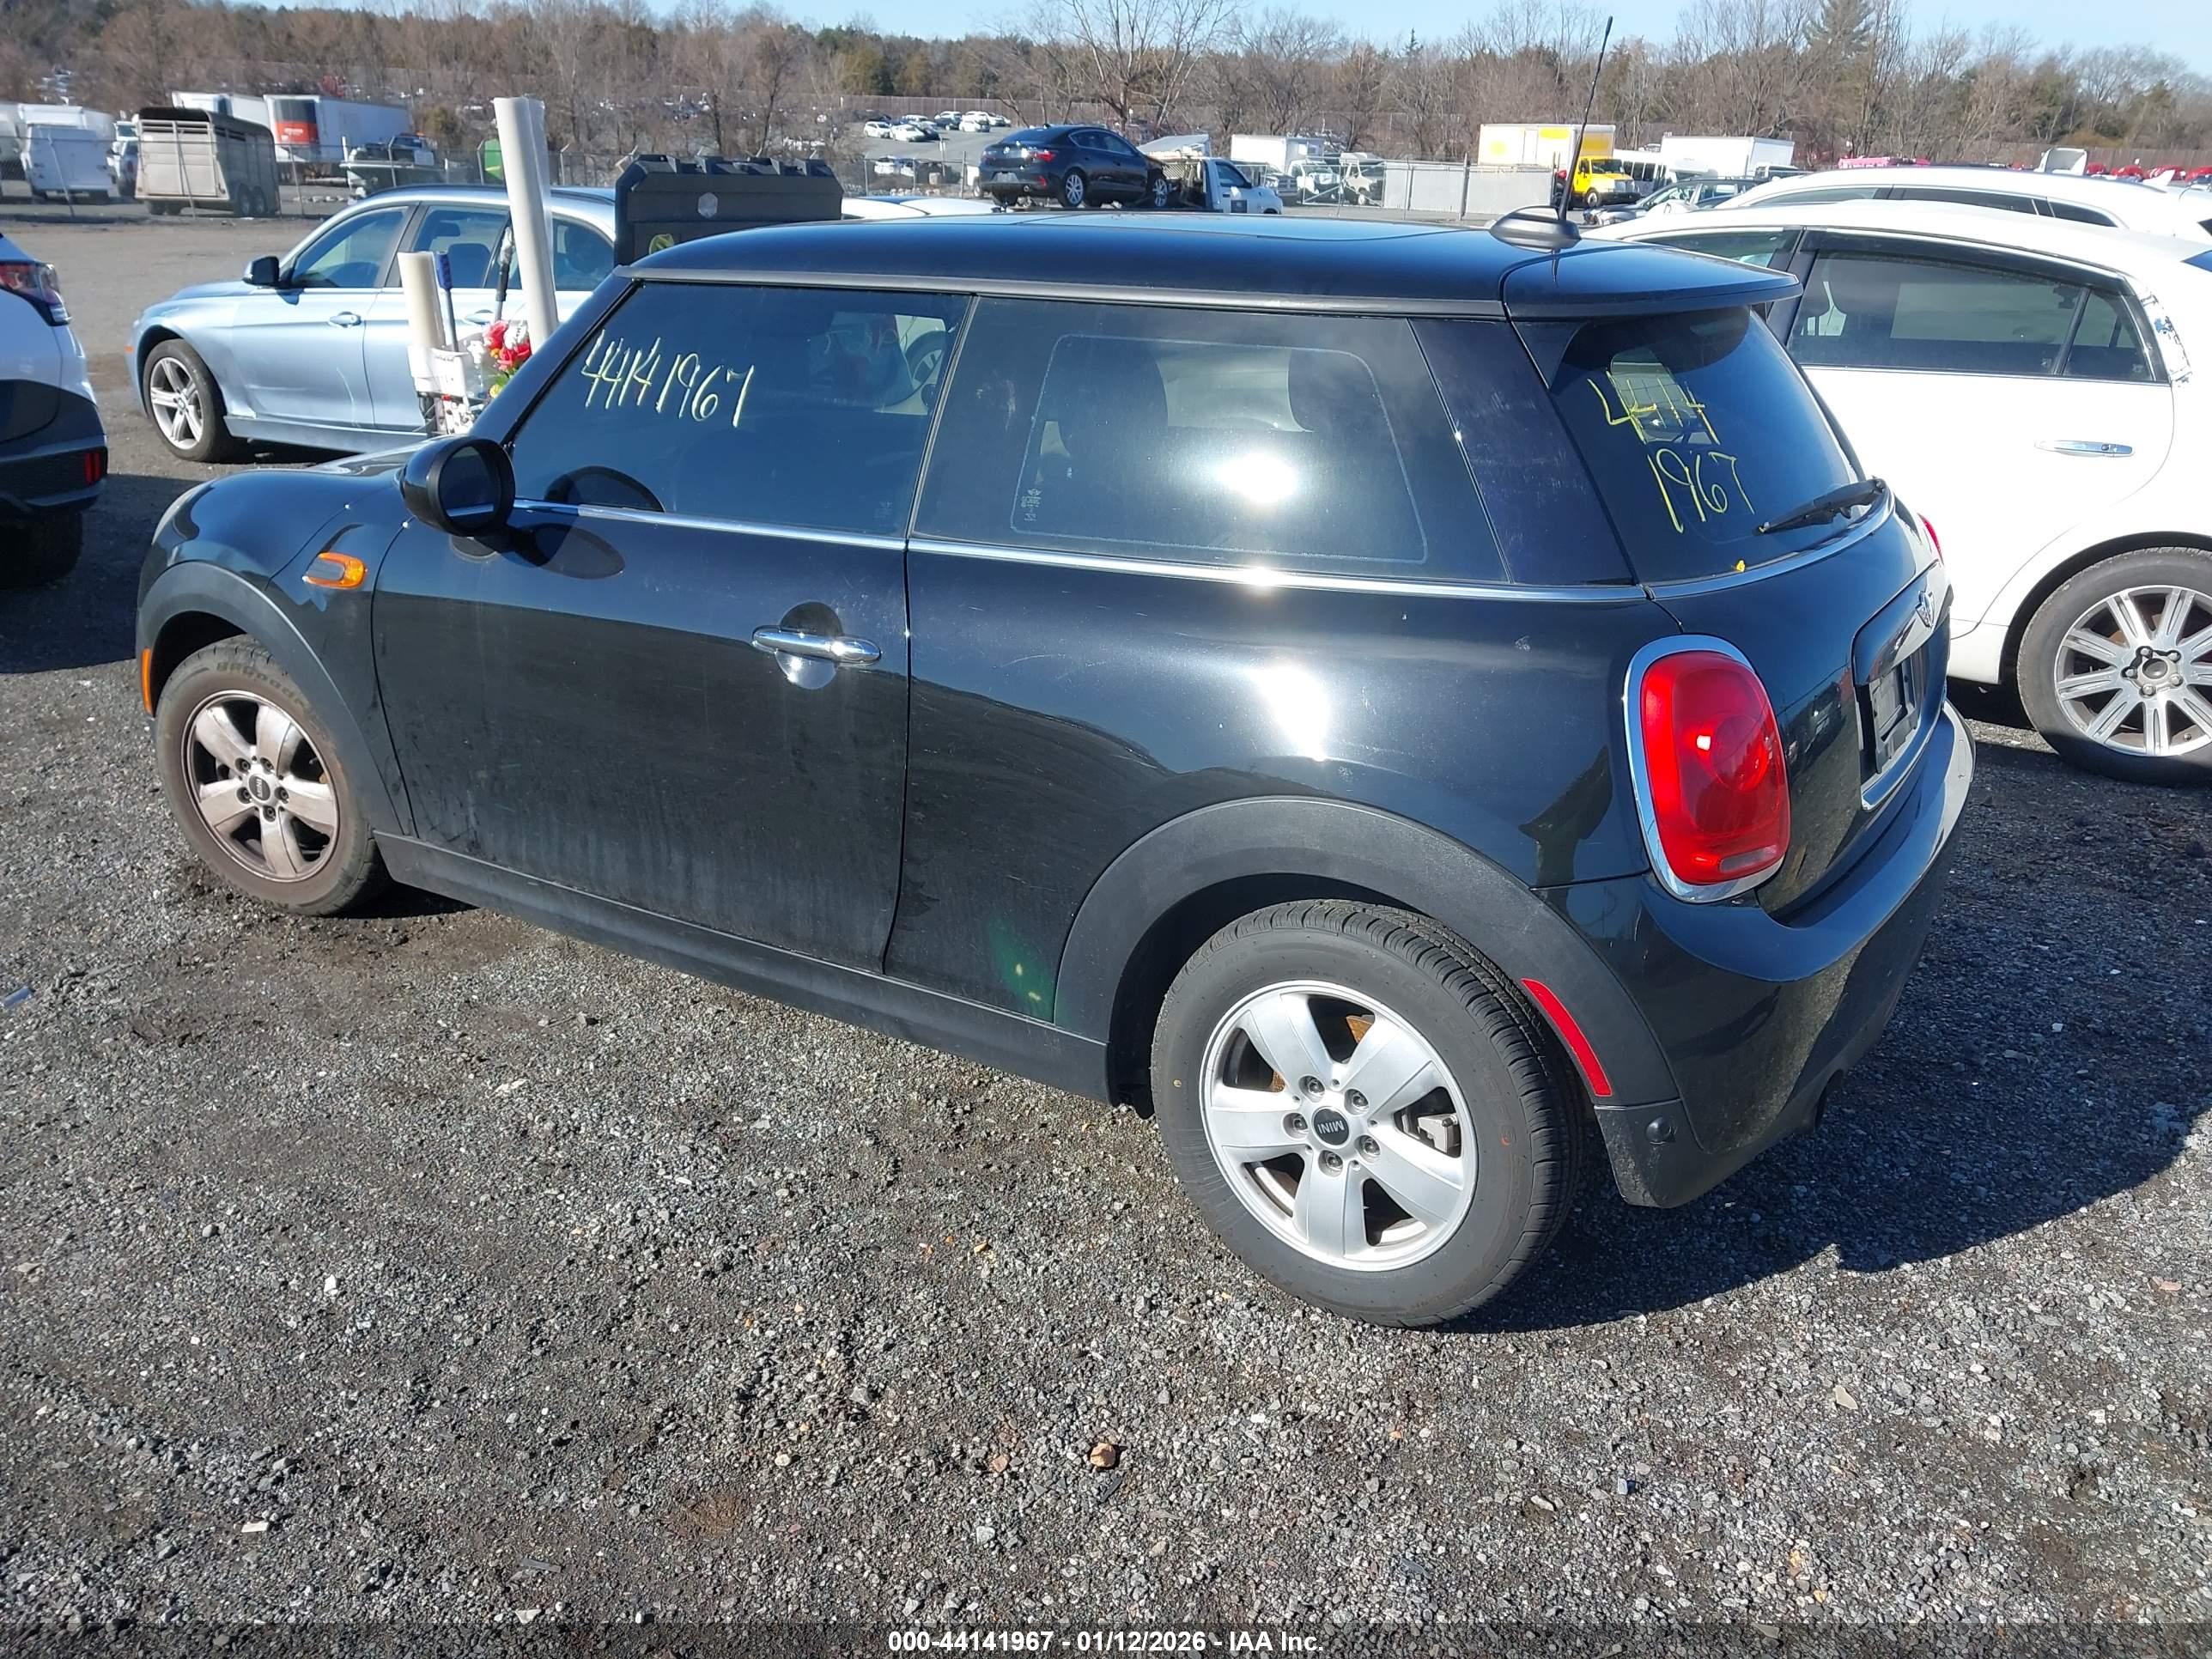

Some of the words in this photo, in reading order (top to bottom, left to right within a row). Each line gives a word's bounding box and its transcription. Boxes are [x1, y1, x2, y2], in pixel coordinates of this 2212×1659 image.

[581, 329, 755, 428] 44141967
[1647, 448, 1755, 534] 1967
[1317, 1120, 1345, 1134] MINI
